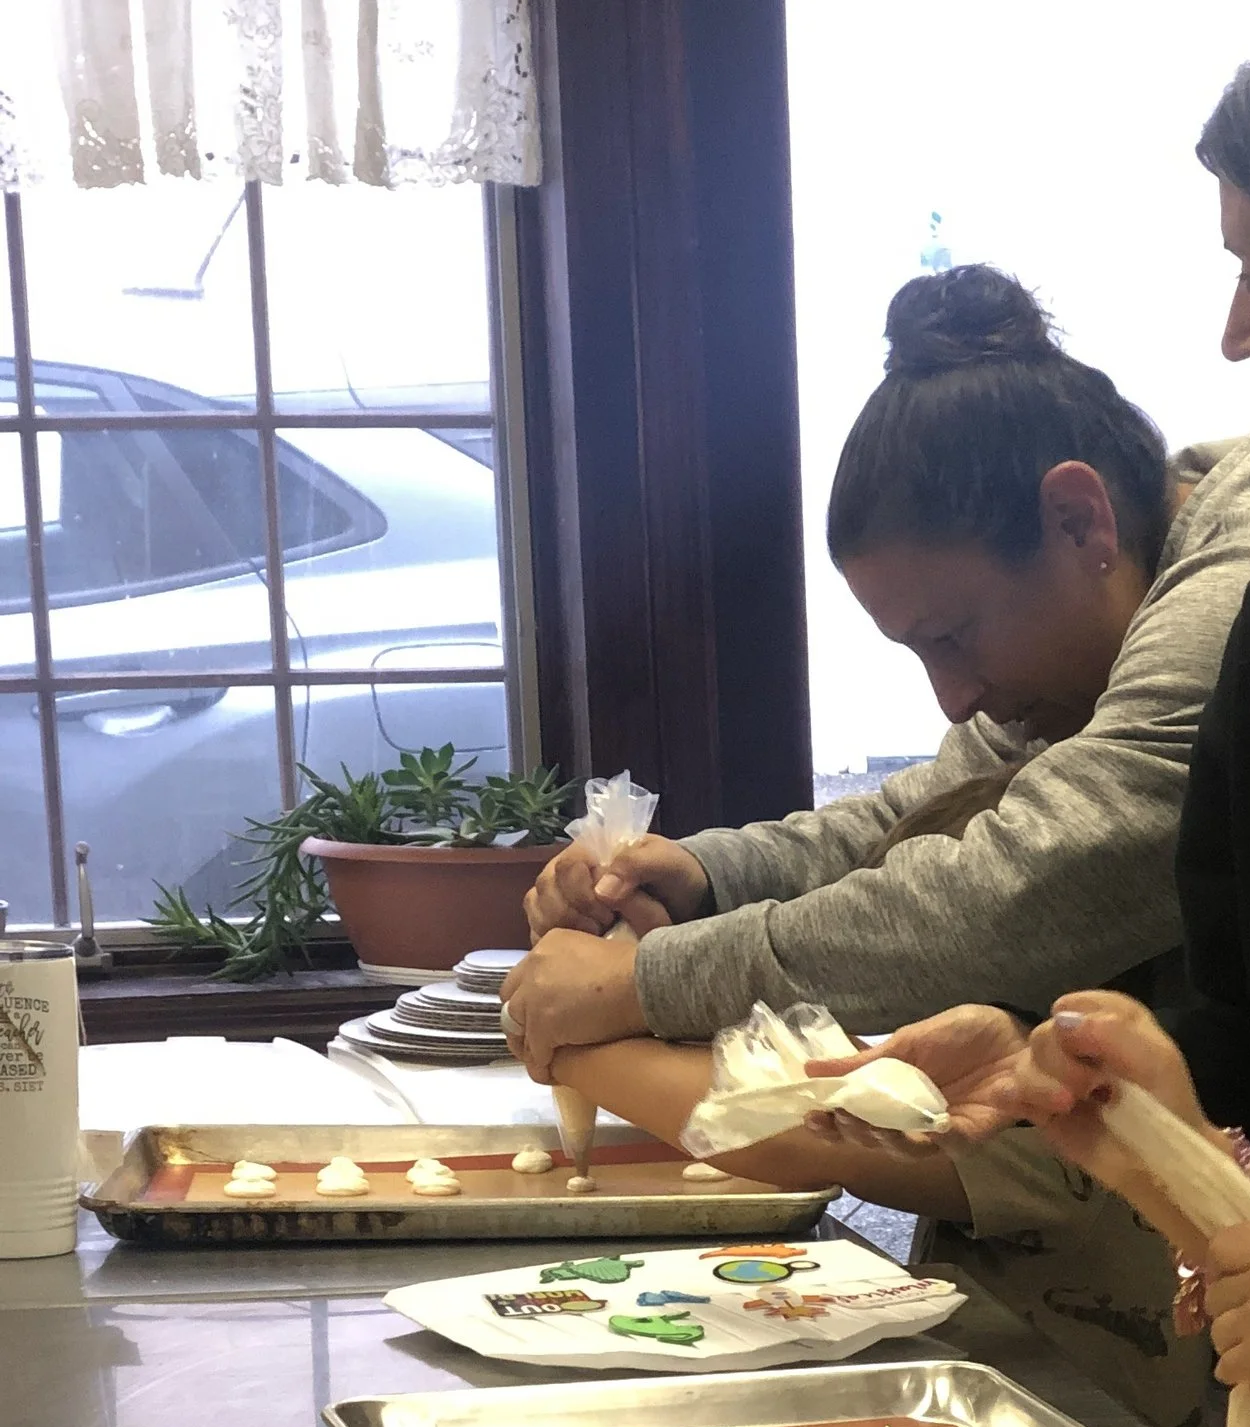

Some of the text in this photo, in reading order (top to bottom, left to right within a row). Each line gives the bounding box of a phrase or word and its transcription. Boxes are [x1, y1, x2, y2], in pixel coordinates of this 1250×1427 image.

[0, 997, 49, 1013] UENCE
[1, 1063, 38, 1077] ASED
[503, 1303, 562, 1316] OUT
